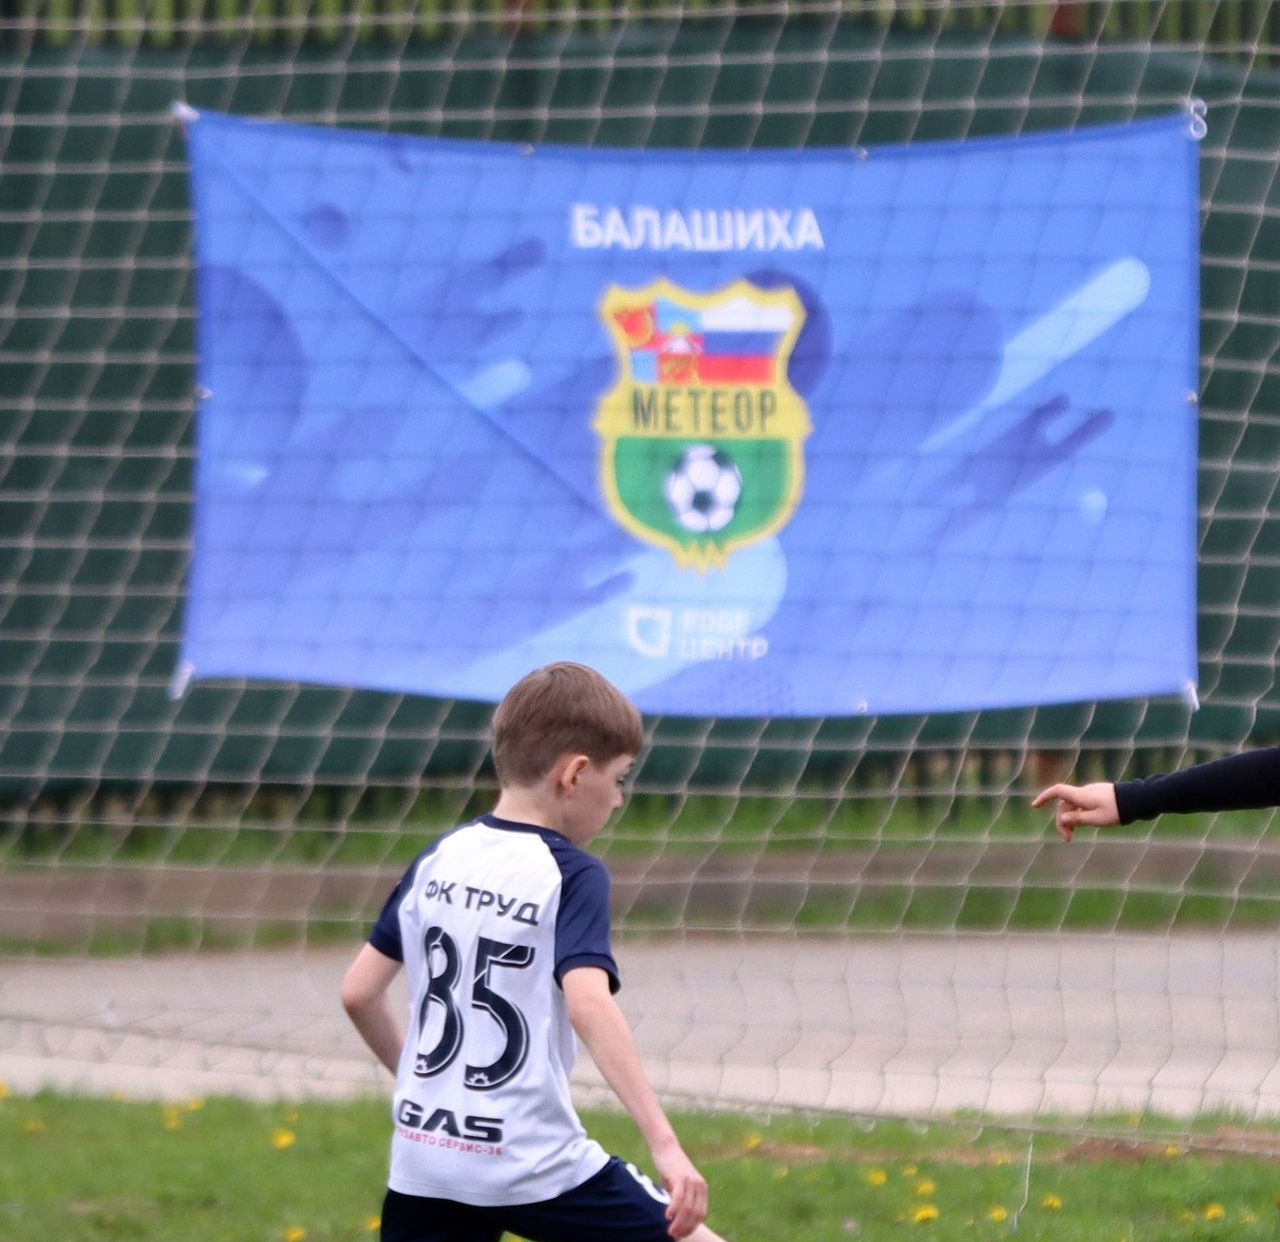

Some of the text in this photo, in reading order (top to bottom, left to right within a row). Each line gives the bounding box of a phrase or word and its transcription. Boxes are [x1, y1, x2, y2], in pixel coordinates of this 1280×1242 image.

[571, 203, 824, 251] БАЛАШИХА
[632, 389, 778, 434] МЕТЕОР
[424, 879, 541, 926] ФК ТРУД
[413, 926, 536, 1091] 85
[398, 1099, 505, 1143] GAS
